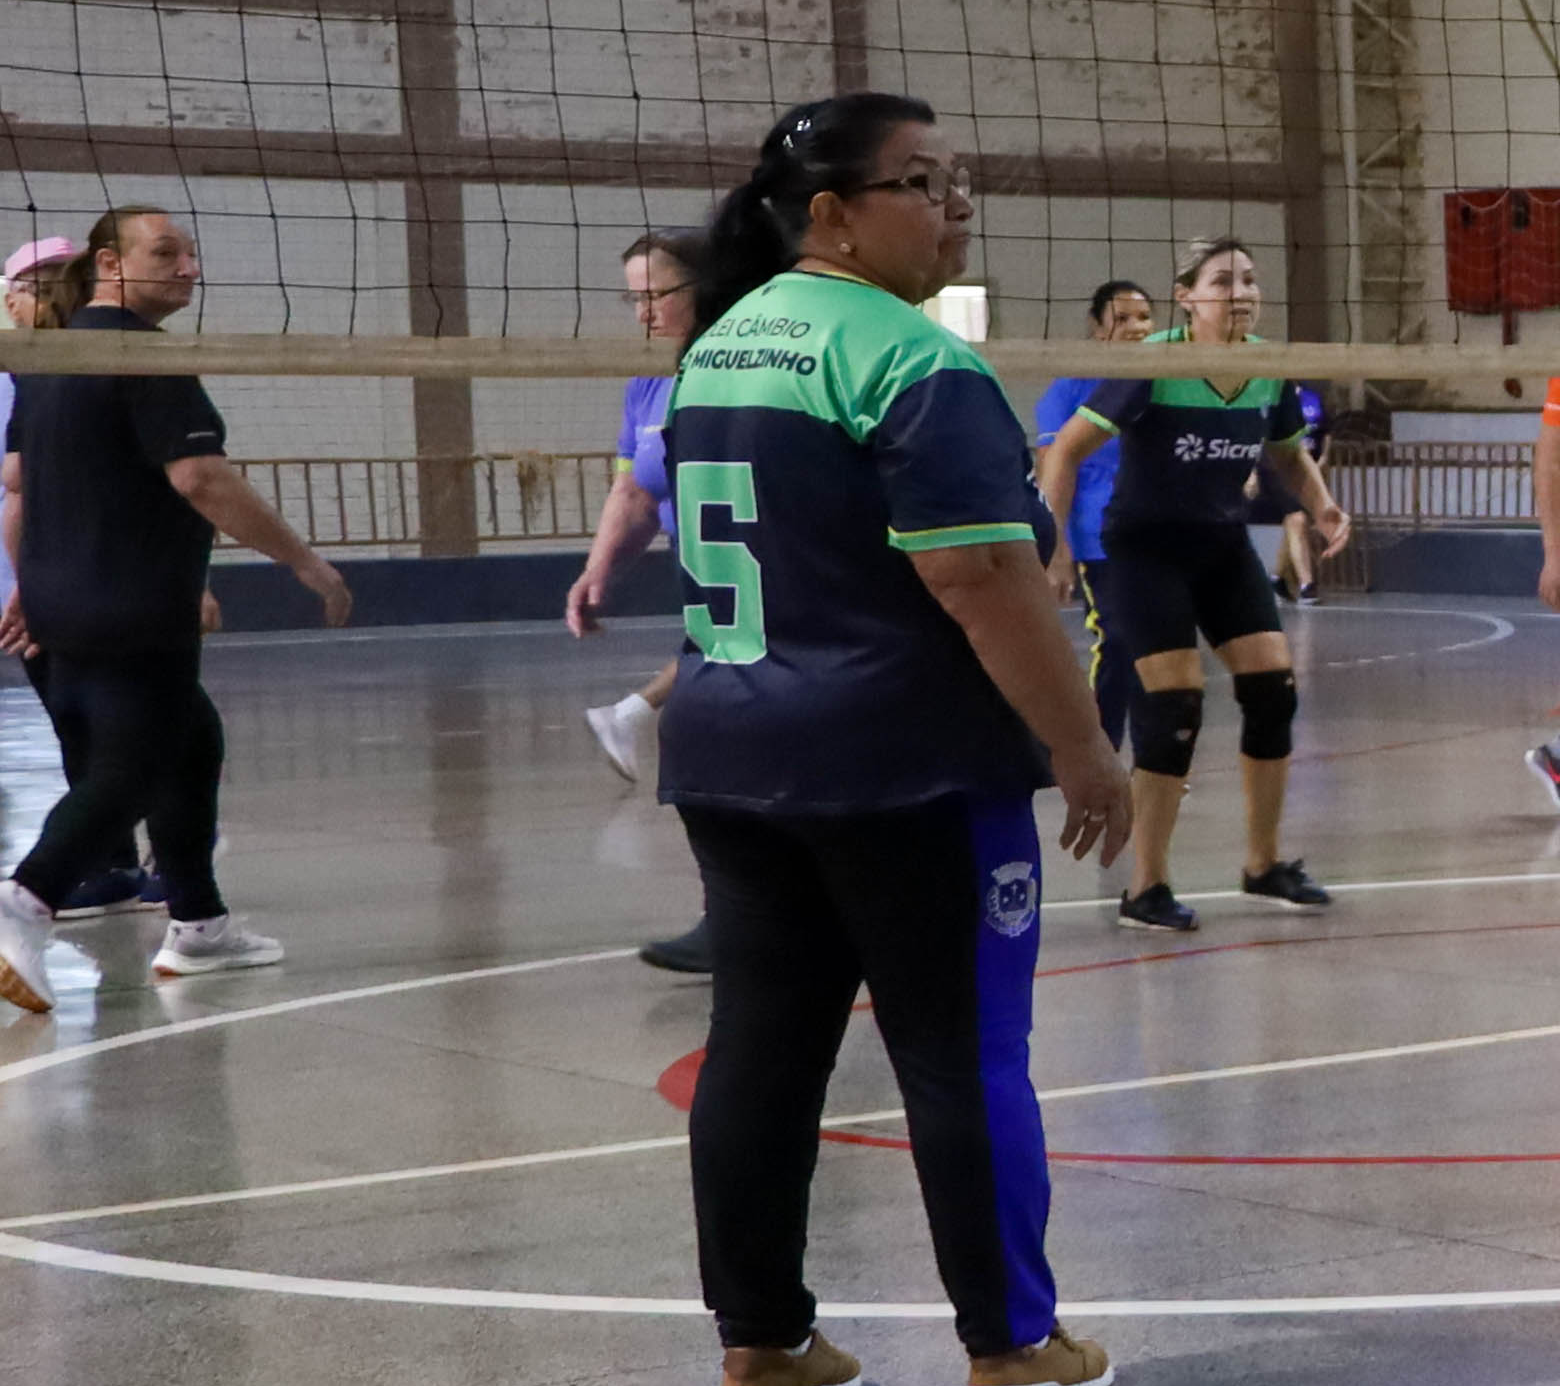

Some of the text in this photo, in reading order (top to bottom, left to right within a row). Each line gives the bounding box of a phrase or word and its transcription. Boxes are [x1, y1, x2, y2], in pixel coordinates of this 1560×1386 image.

[736, 314, 811, 339] CÂMBIO
[692, 348, 817, 376] MIGUELZINHO
[676, 461, 768, 664] 5
